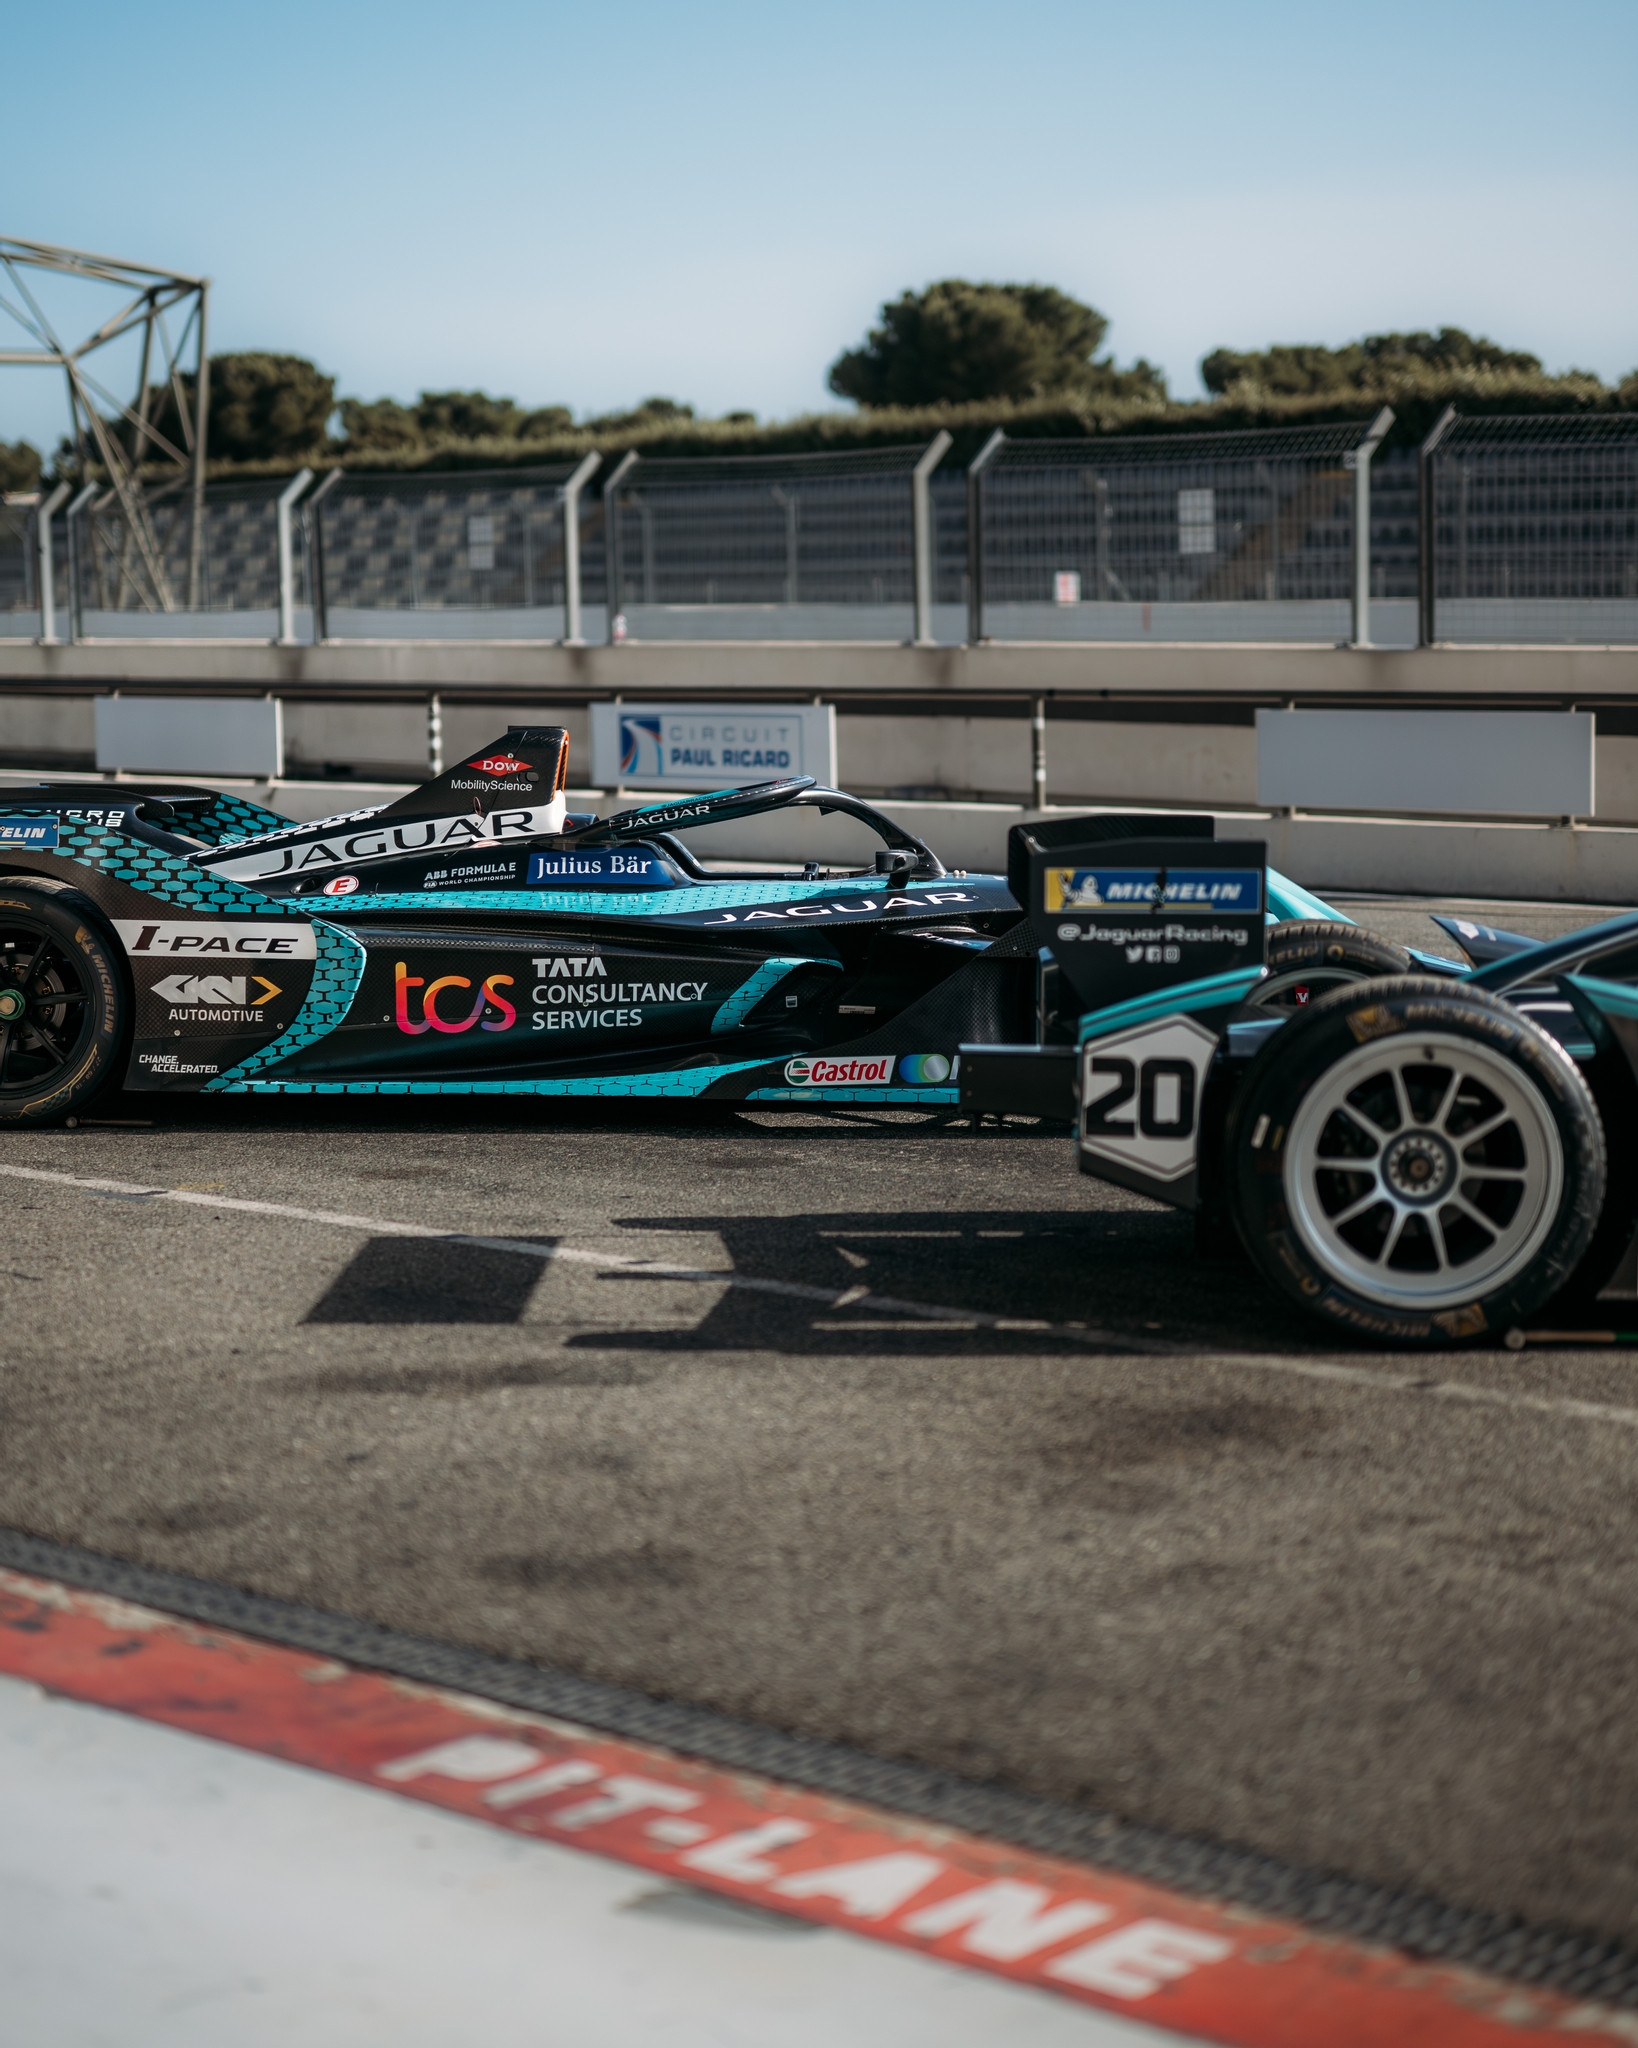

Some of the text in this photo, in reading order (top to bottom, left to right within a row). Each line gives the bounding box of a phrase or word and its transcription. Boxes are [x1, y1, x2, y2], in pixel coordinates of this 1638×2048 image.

[669, 726, 790, 742] CIRCUIT
[671, 748, 790, 769] PAUL RICARD
[451, 779, 533, 792] MobilityScience
[620, 805, 711, 830] JAGUAR
[258, 811, 536, 877] JAGUAR
[424, 862, 516, 881] ABB FORMULA E
[536, 855, 652, 879] Julius Bär
[438, 878, 462, 886] WORLD
[464, 874, 516, 884] CHAMPIONSHIP
[703, 892, 974, 925] JAGUAR
[131, 925, 299, 954] I-PACE
[1057, 923, 1248, 946] @JaguarRacing
[532, 957, 608, 978] TATA
[92, 954, 115, 1034] MICHELIN
[395, 961, 517, 1035] tcs
[532, 982, 708, 1005] CONSULTANCY
[168, 1008, 264, 1022] AUTOMOTIVE
[532, 1008, 643, 1031] SERVICES
[138, 1054, 180, 1065] CHANGE.
[151, 1063, 219, 1074] ACCELERATED.
[811, 1059, 888, 1083] Castrol
[1086, 1058, 1197, 1140] 20
[376, 1736, 1235, 2001] PIT-LANE
